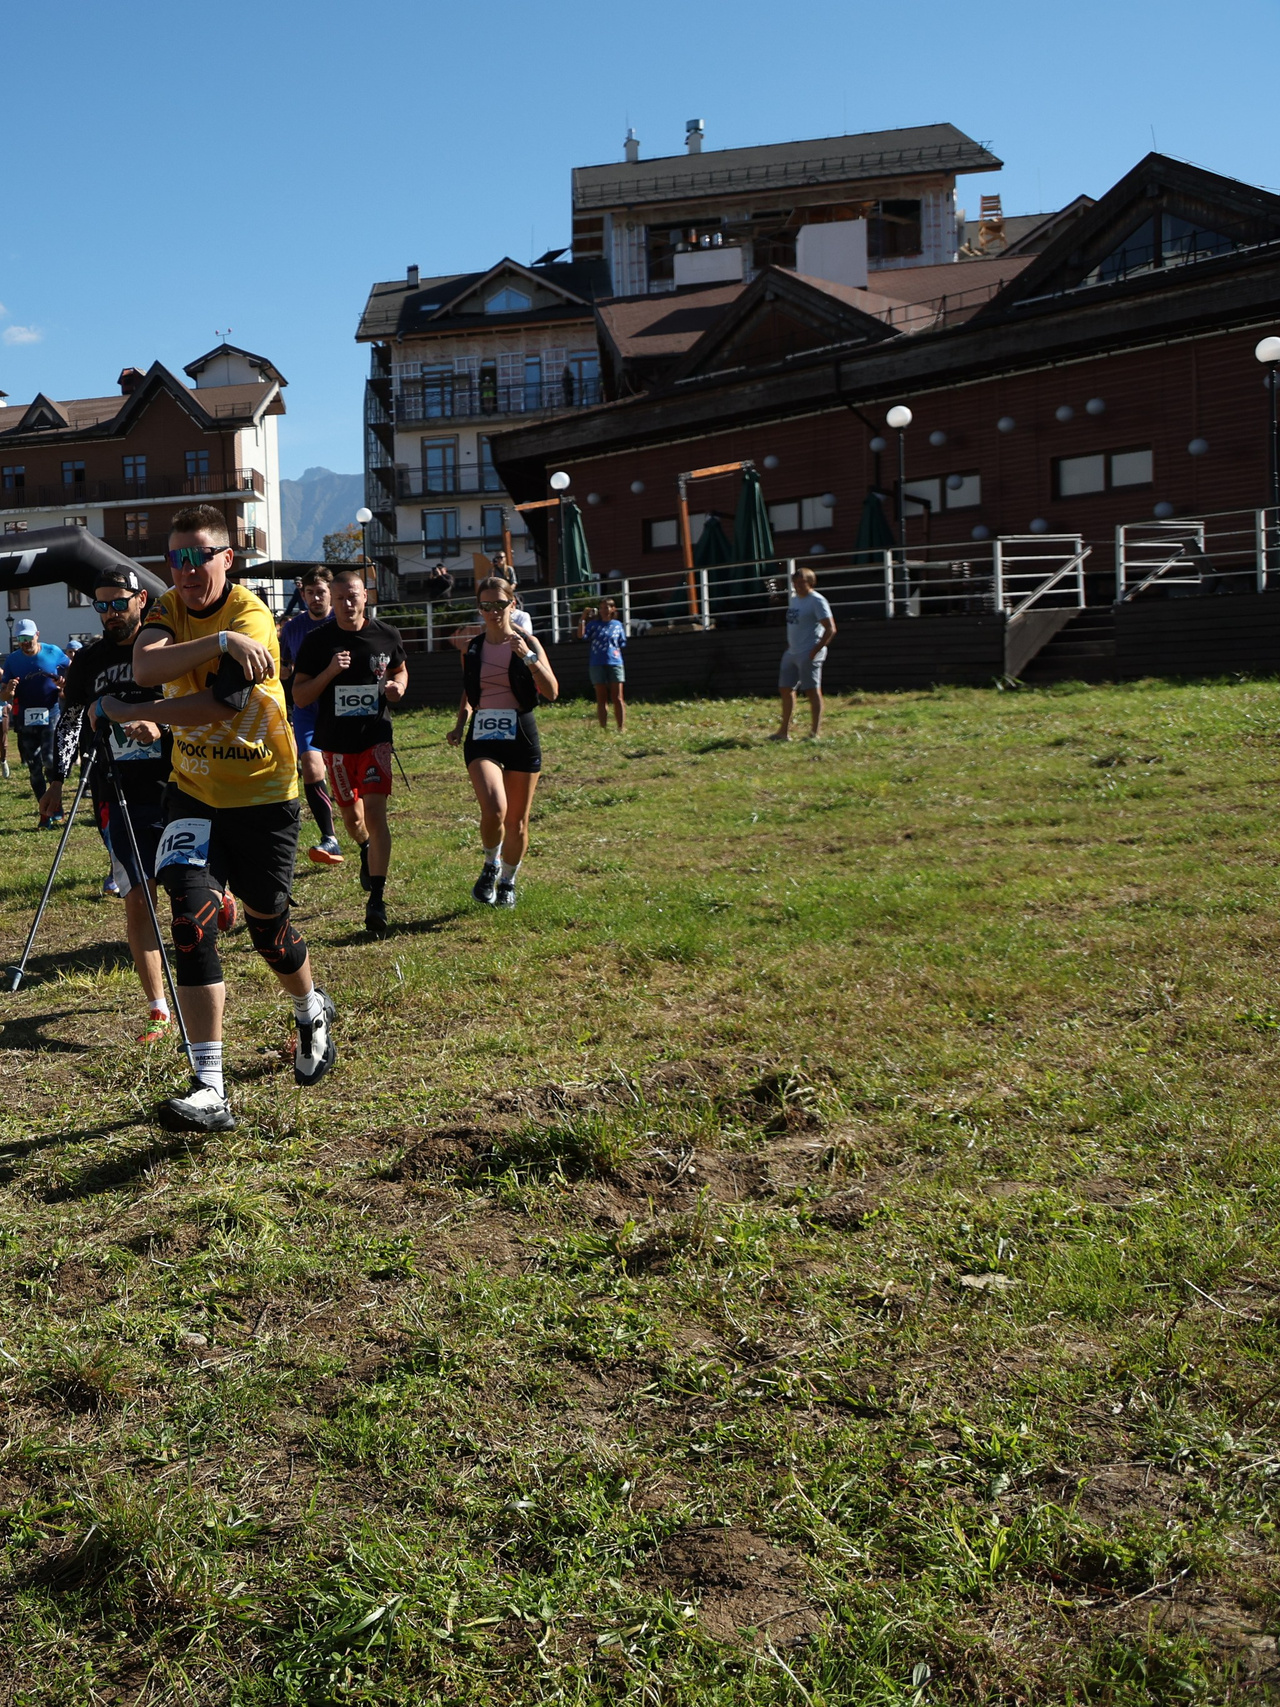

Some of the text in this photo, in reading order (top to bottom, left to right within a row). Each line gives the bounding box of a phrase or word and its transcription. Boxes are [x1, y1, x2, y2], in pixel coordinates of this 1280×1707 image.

[339, 694, 375, 707] 160
[29, 712, 44, 720] 171
[477, 717, 513, 730] 168
[160, 831, 196, 857] 112
